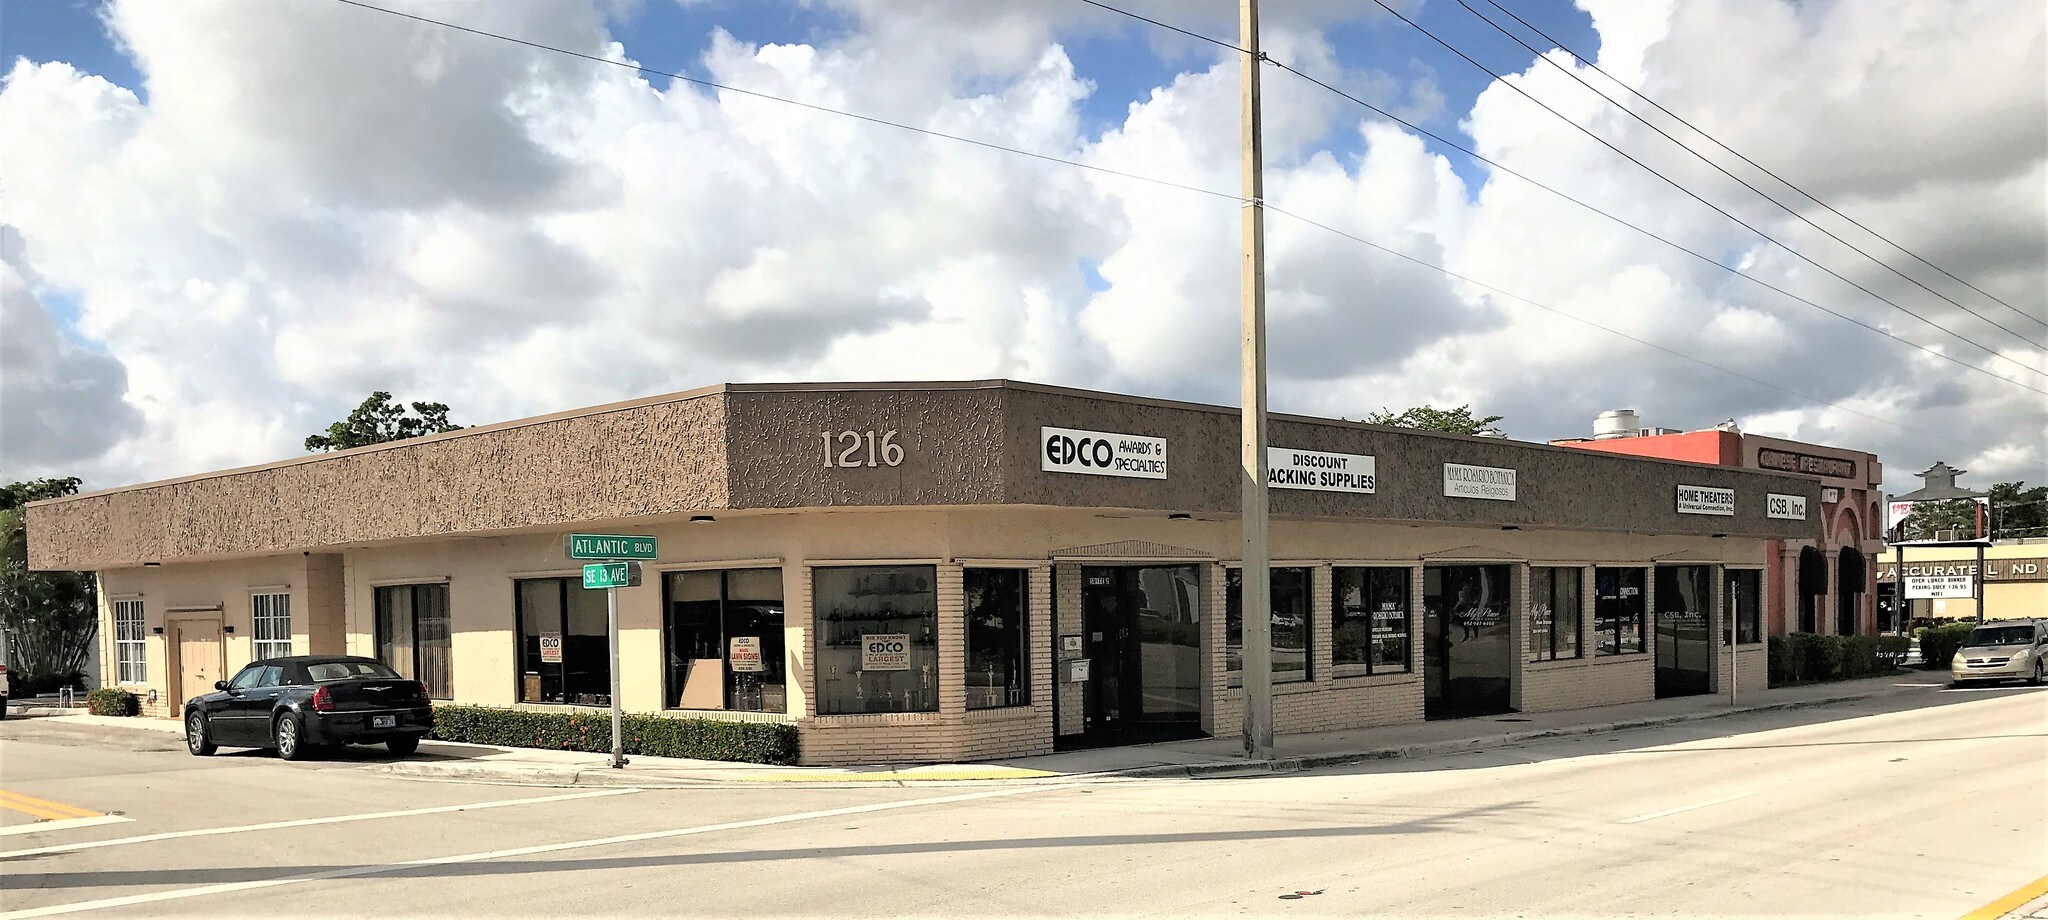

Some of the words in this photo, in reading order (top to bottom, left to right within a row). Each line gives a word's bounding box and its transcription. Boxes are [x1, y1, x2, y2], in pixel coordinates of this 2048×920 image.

[821, 430, 904, 468] 1216
[1046, 434, 1113, 468] EDCO
[1118, 440, 1151, 455] AWARDS
[1155, 443, 1162, 455] &
[1114, 457, 1166, 474] SPECIALTIES
[1292, 454, 1348, 470] DISCOUNT
[1266, 467, 1316, 486] ACKING
[1320, 471, 1374, 490] SUPPLIES
[1678, 488, 1699, 503] HOME
[1700, 490, 1733, 505] THEATERS
[1769, 497, 1790, 518] CSB,
[1792, 500, 1805, 517] Inc.
[575, 539, 628, 554] ATLANTIC
[634, 542, 653, 553] BLVD
[586, 569, 596, 584] SE
[600, 568, 608, 583] 13
[611, 567, 625, 582] AVE
[1459, 606, 1477, 620] My
[1664, 611, 1682, 619] CSB,
[542, 638, 559, 648] EDCO
[868, 642, 904, 653] EDCO
